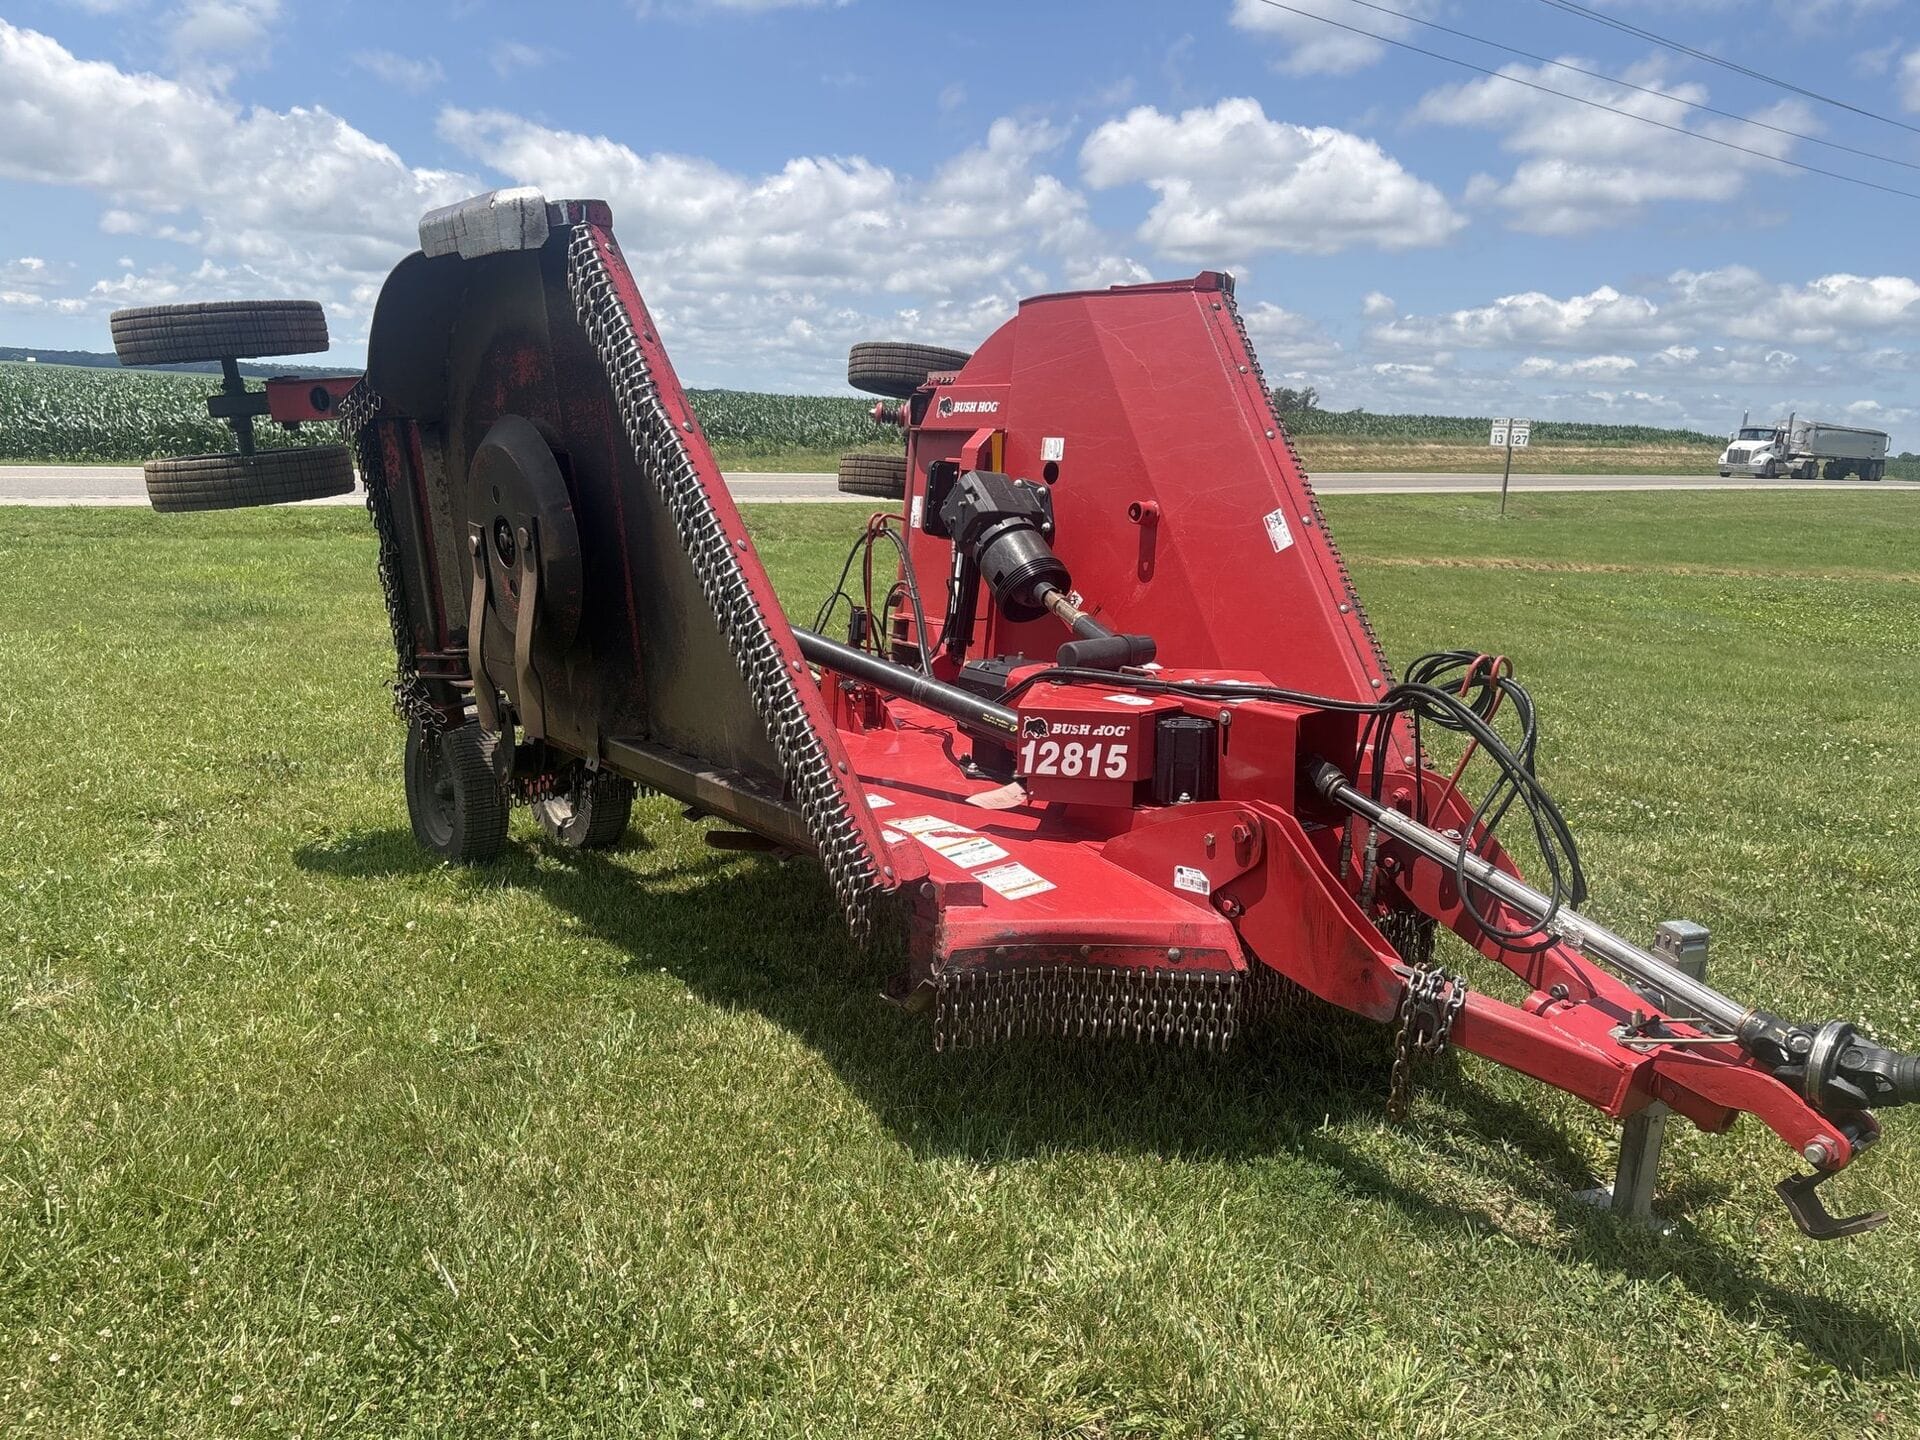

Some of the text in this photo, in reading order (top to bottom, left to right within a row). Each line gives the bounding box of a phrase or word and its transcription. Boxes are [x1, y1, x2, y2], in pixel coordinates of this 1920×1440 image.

[953, 401, 998, 413] BUSH HOG
[1494, 434, 1504, 444] 13
[1511, 434, 1528, 445] 127
[1051, 723, 1091, 735] BUSH
[1021, 740, 1128, 779] 12815
